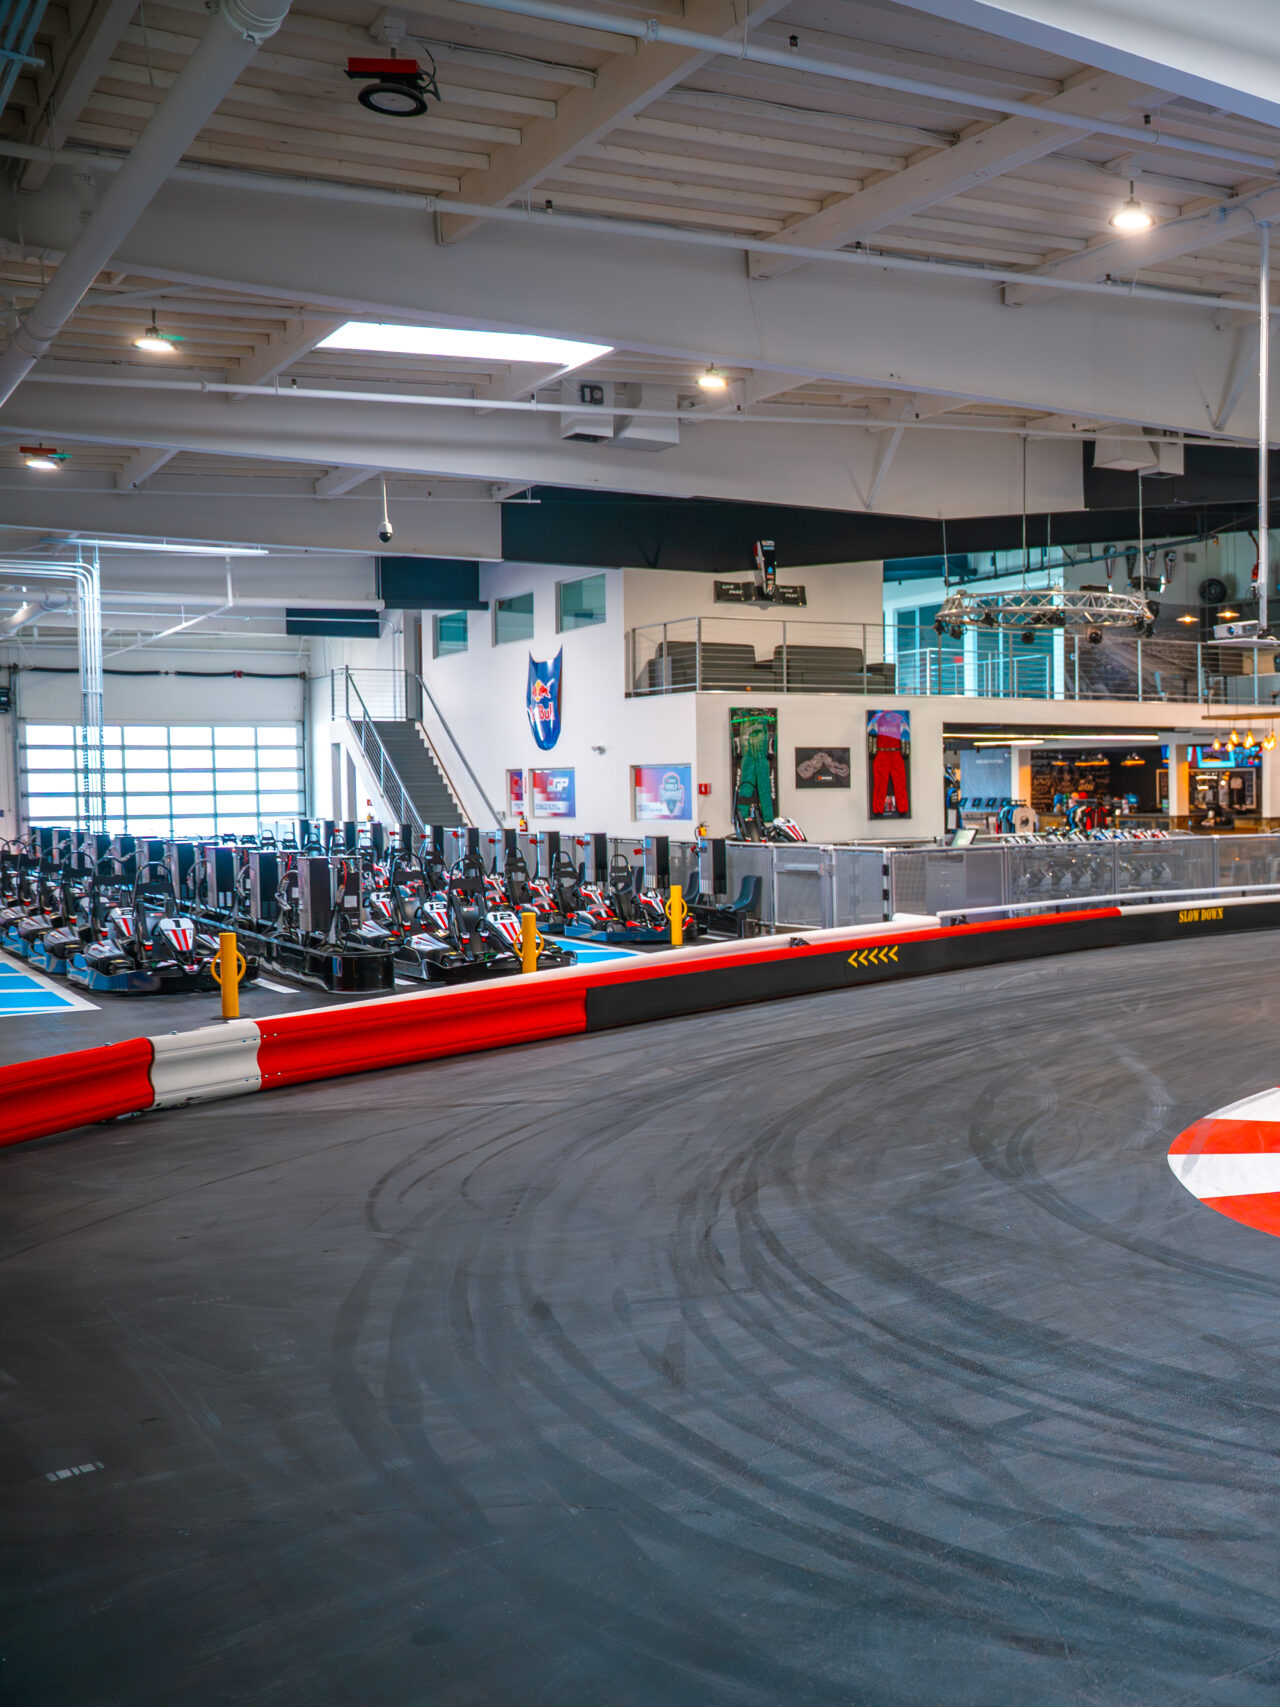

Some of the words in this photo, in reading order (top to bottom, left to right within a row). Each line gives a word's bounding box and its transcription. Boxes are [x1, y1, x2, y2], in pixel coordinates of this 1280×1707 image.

[429, 903, 447, 911] 13
[492, 913, 513, 922] 12
[1179, 909, 1200, 923] SLOW
[1201, 907, 1224, 921] DOWN
[171, 919, 182, 929] 1
